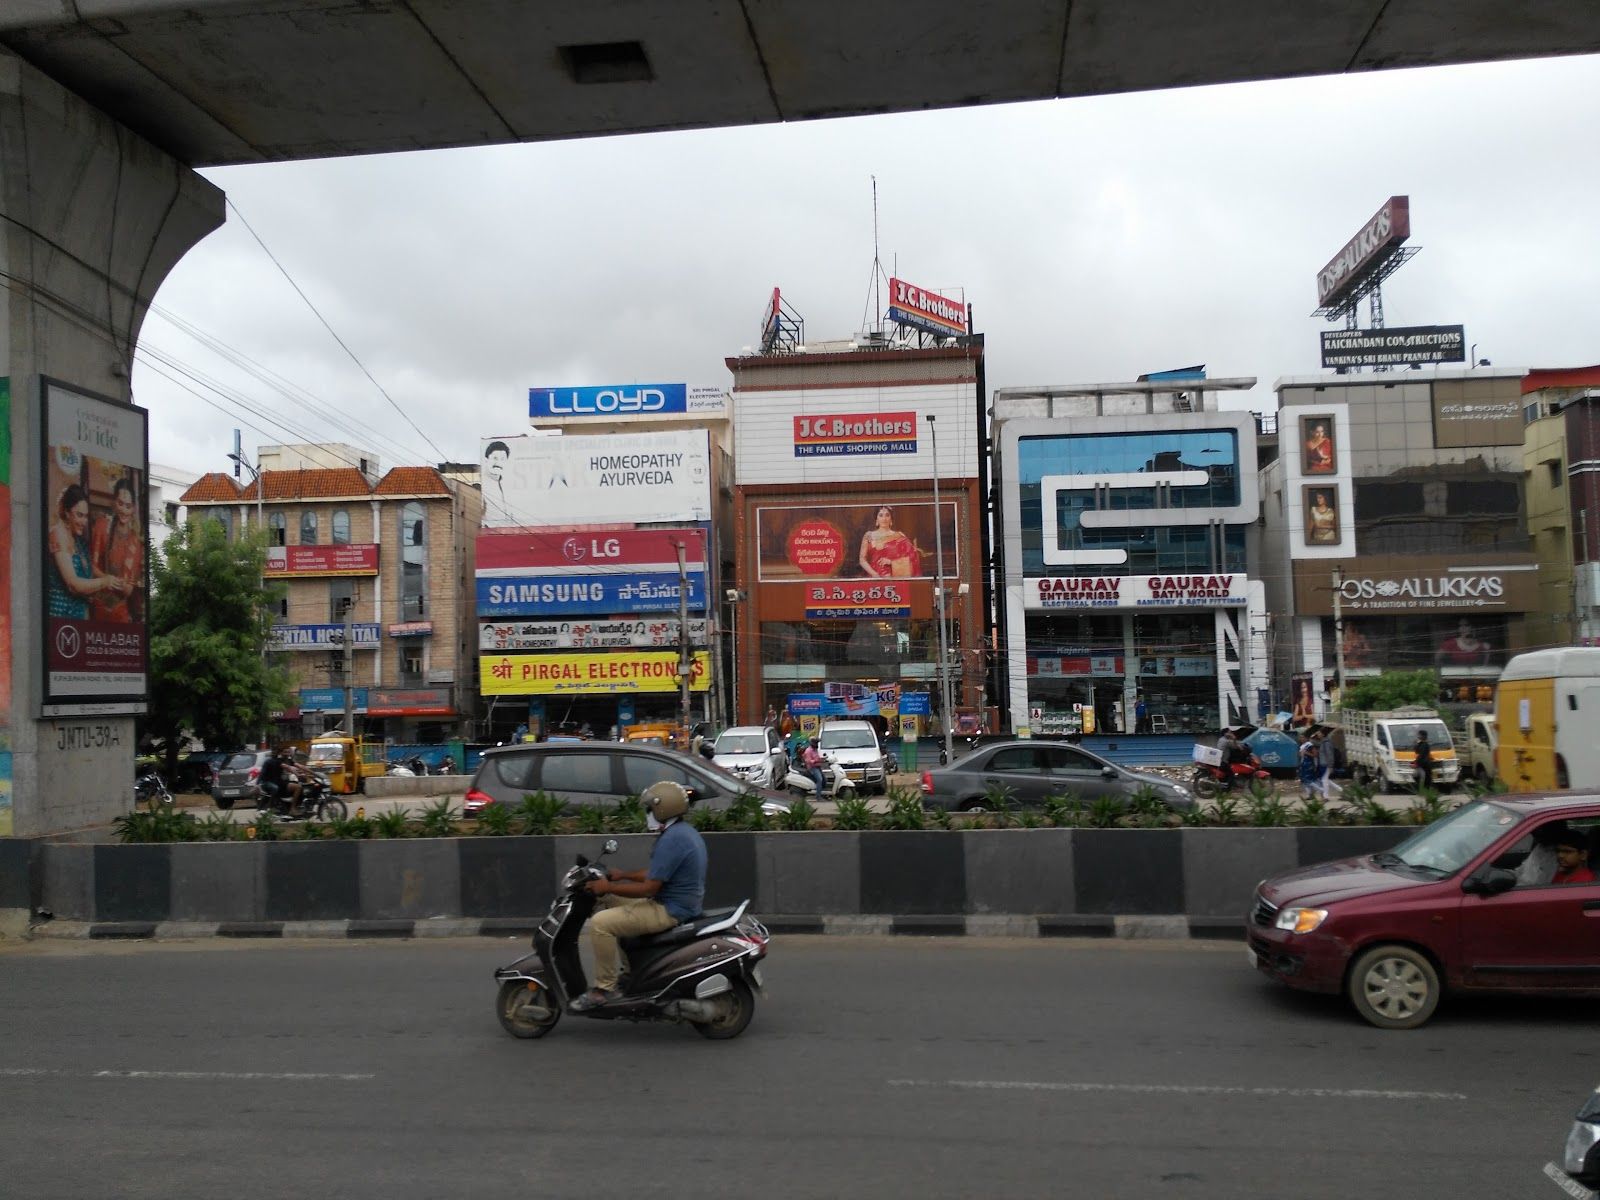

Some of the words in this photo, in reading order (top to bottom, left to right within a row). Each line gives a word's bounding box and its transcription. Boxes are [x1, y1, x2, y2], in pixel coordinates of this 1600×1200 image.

[1325, 338, 1384, 349] RAICHANDANI
[1386, 333, 1460, 347] CONSTRUCTIONS
[1363, 354, 1376, 363] SRI
[1376, 353, 1402, 362] BHANU
[1403, 352, 1430, 361] PRANAY
[549, 389, 665, 414] LLOYD
[78, 420, 118, 449] Bride
[800, 418, 912, 438] J.C.Brothers
[799, 446, 813, 454] THE
[816, 445, 843, 454] FAMILY
[846, 444, 888, 452] SHOPPING
[891, 443, 913, 451] MALL
[590, 453, 683, 470] HOMEOPATHY
[599, 471, 674, 487] AYURVEDA
[592, 538, 620, 557] LG
[1038, 578, 1121, 592] GAURAV
[1148, 576, 1233, 590] GAURAV
[1399, 576, 1503, 598] ALUKKAS
[489, 582, 603, 604] SAMSUNG
[1040, 592, 1120, 600] ENTERPRISES
[1152, 590, 1184, 599] BATH
[1187, 589, 1230, 598] WORLD
[85, 632, 140, 647] MALABAR
[492, 658, 512, 680] श्री
[522, 663, 581, 680] PIRGAL
[588, 661, 704, 679] ELECTRONS
